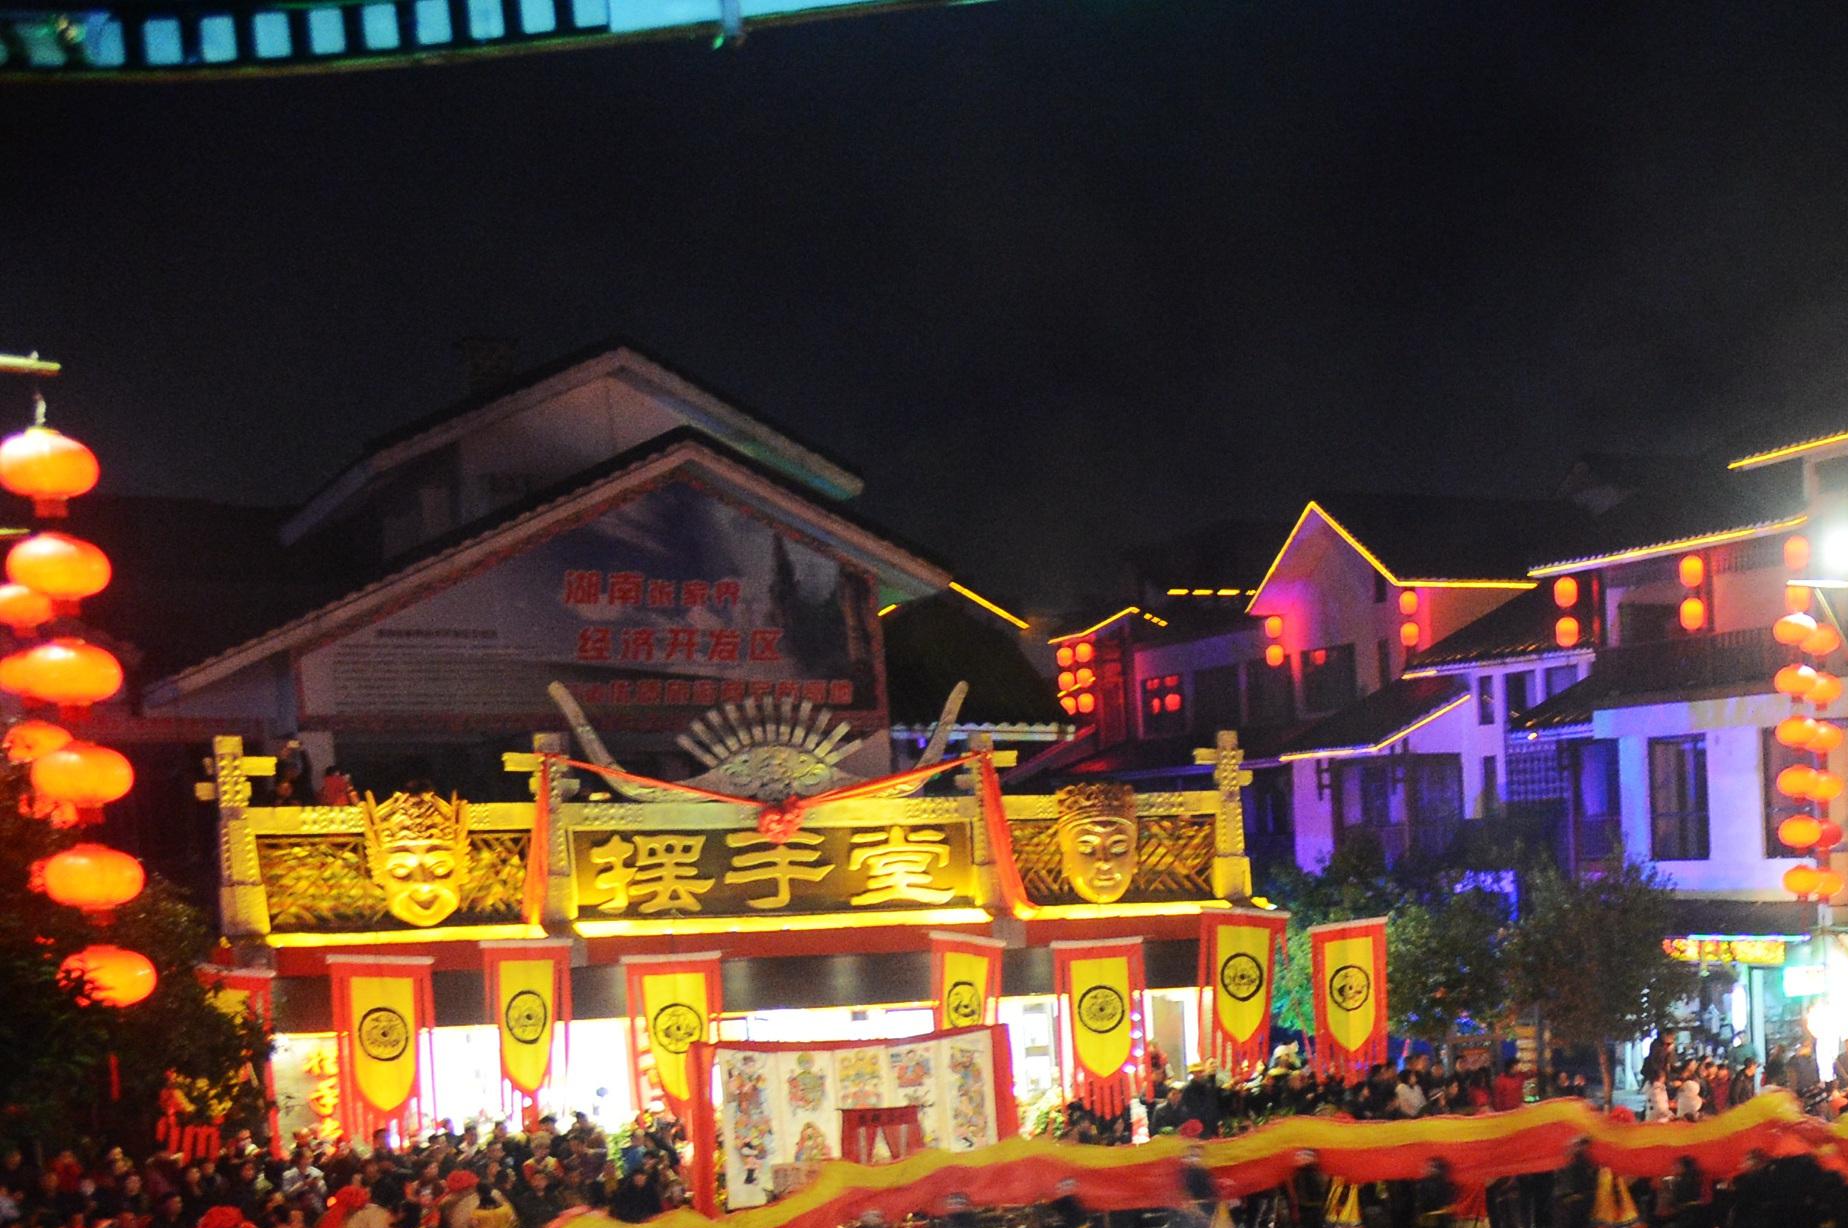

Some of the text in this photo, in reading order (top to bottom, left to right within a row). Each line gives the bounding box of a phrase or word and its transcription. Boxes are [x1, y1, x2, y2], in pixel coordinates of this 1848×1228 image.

[577, 626, 784, 663] 经济开发区
[590, 824, 957, 914] 摆手堂
